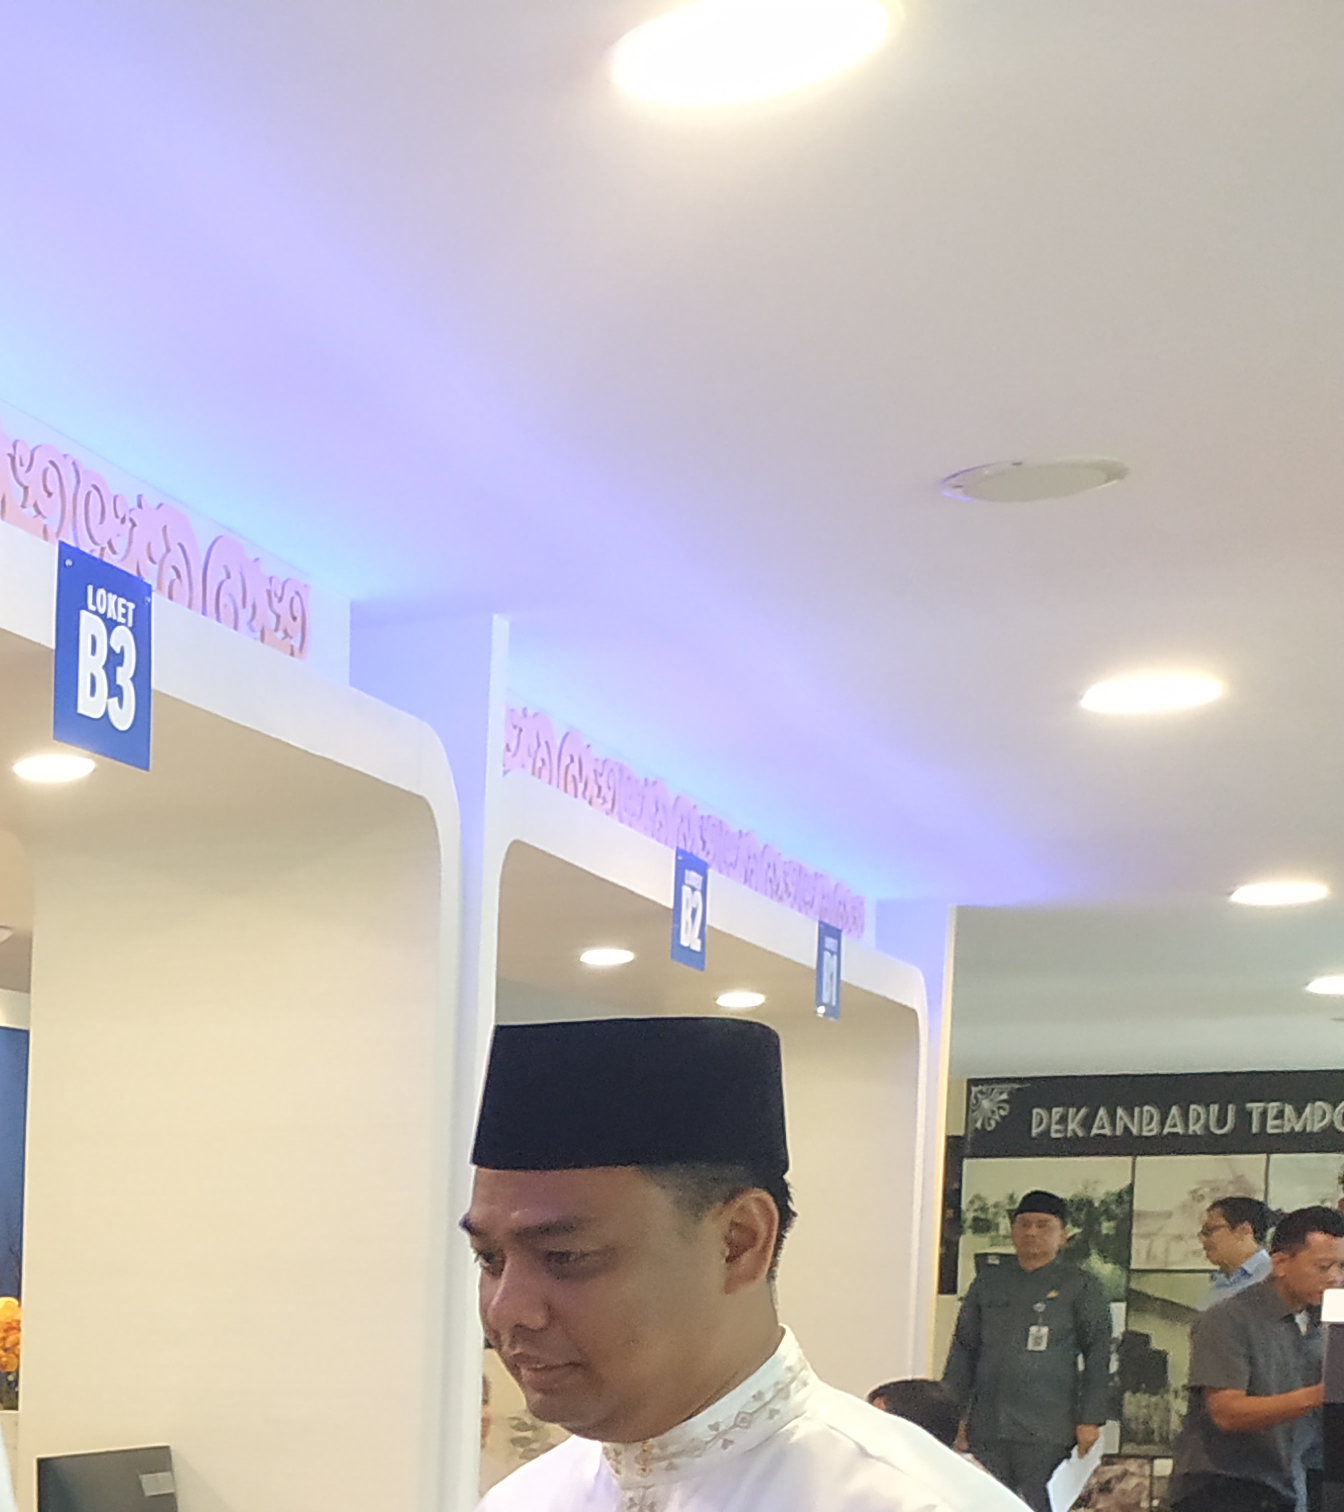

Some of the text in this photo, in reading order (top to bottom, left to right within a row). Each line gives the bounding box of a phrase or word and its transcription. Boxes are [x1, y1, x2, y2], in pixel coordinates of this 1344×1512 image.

[86, 584, 136, 628] LOKET
[76, 608, 137, 732] B3
[1030, 1103, 1236, 1139] PEKANBARU
